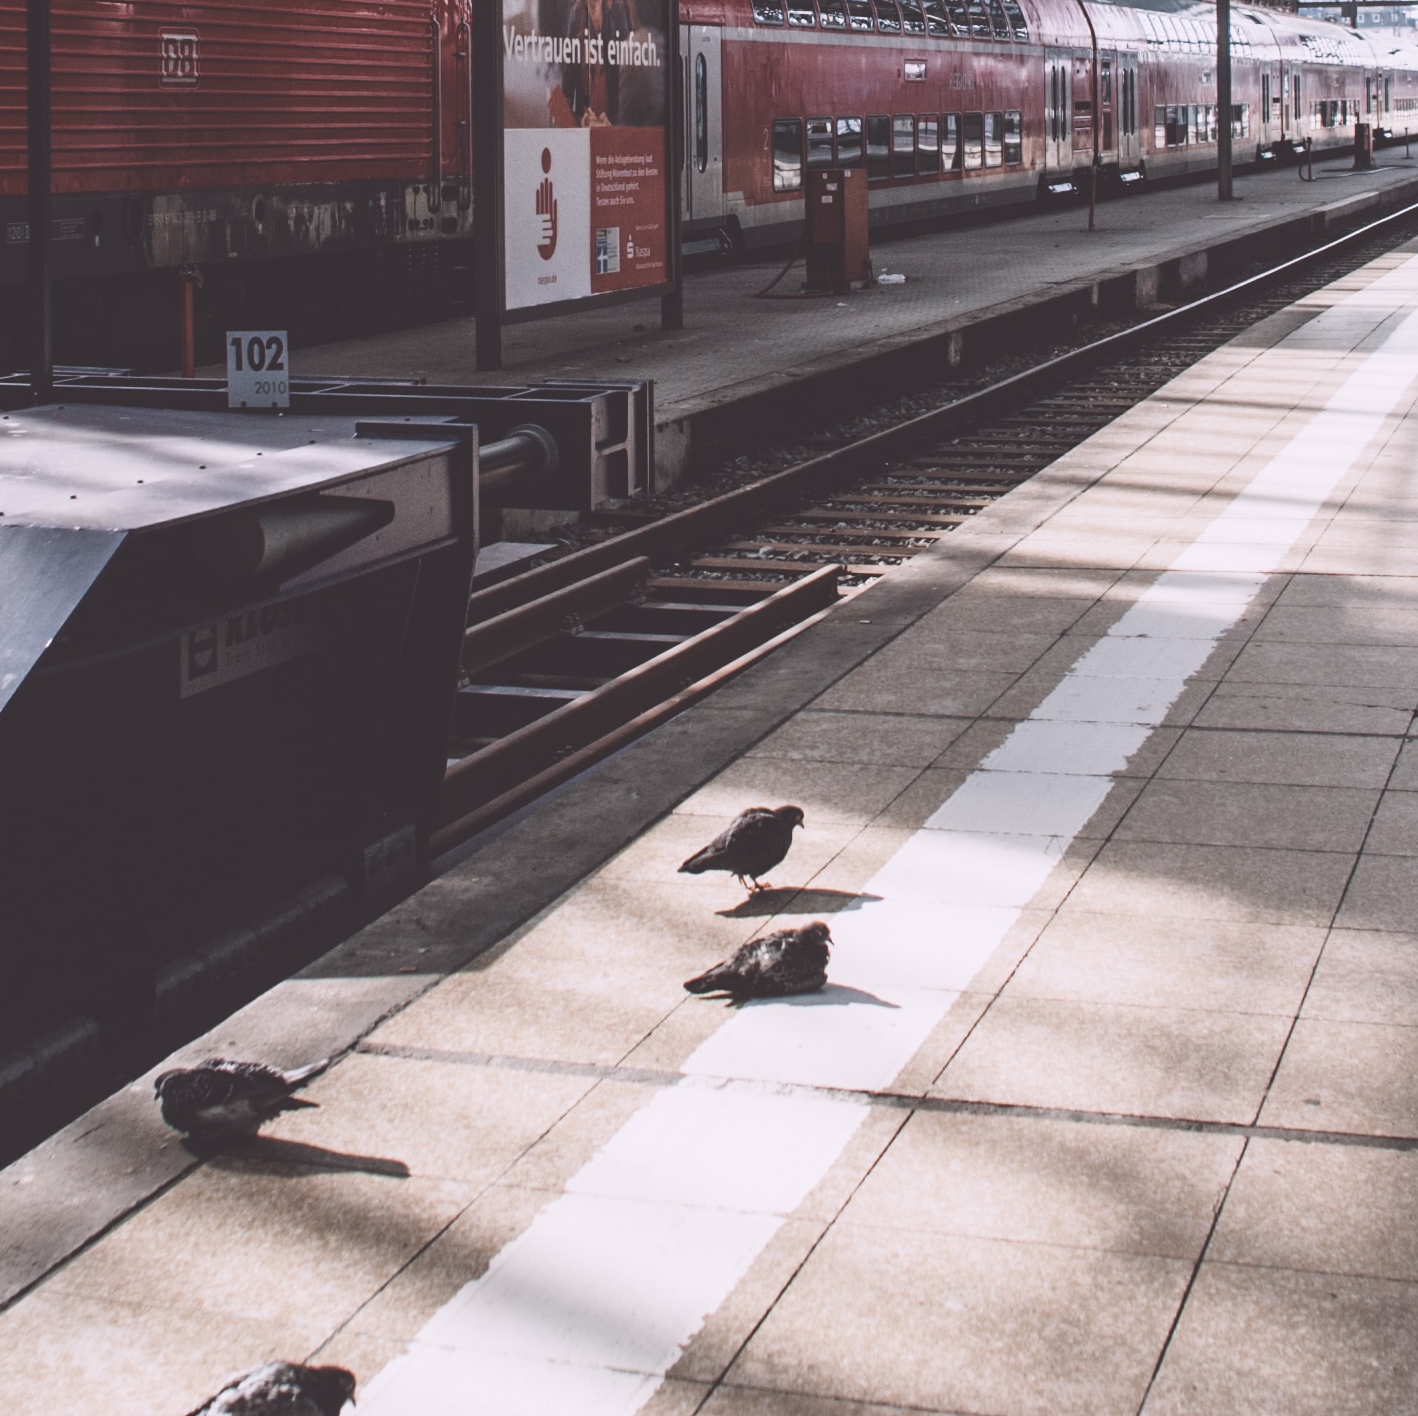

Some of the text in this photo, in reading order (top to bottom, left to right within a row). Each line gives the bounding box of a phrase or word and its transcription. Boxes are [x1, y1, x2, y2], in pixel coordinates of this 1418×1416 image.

[165, 38, 196, 78] DB
[503, 25, 661, 66] Vertrauen ist einfach.
[764, 127, 770, 151] 2
[230, 336, 285, 372] 102
[254, 381, 287, 395] 2010
